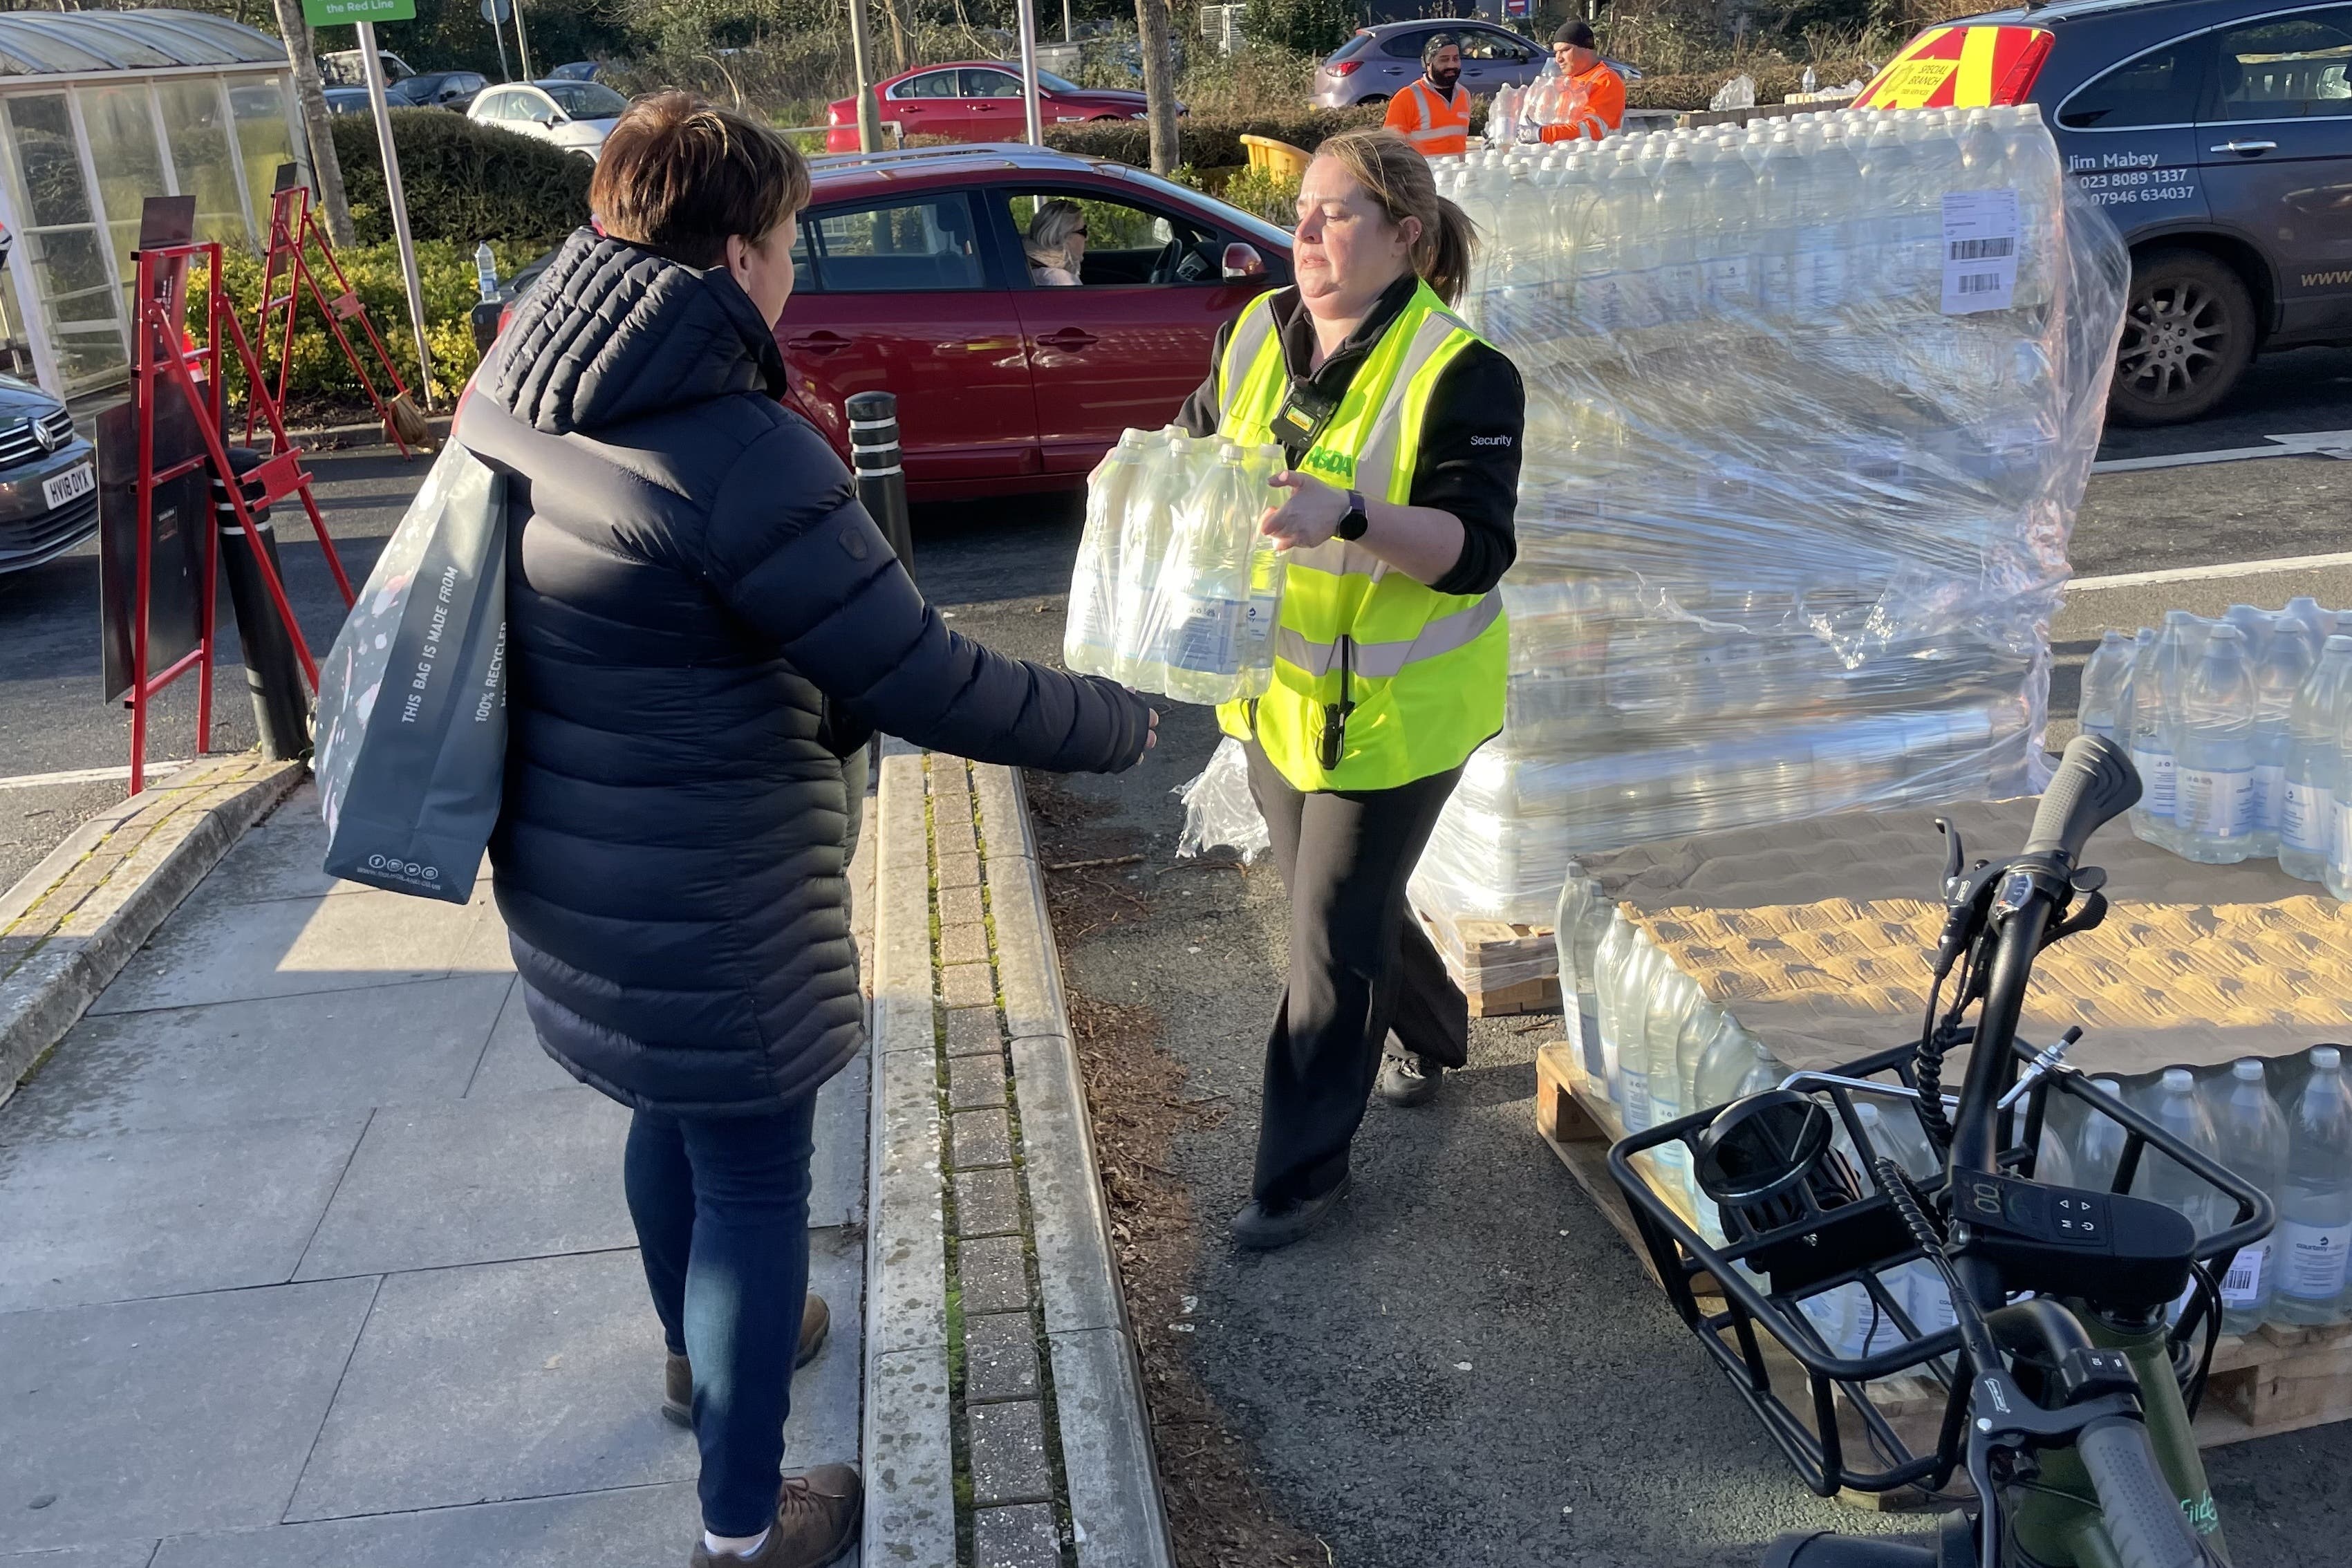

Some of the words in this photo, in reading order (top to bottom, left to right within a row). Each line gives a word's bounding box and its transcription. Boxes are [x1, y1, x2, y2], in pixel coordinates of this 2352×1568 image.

[326, 3, 344, 14] the
[347, 1, 368, 12] Red
[371, 0, 394, 9] Line
[2068, 154, 2096, 173] Jim
[2103, 151, 2158, 169] Mabey
[2080, 176, 2107, 189] 023
[2111, 171, 2148, 187] 8089
[2152, 169, 2187, 183] 1337
[2091, 191, 2137, 205] 07946
[2140, 186, 2194, 202] 634037
[1470, 434, 1512, 447] Security
[1305, 445, 1353, 478] ASDA
[49, 476, 73, 504] HV18
[71, 467, 90, 493] OYX
[438, 566, 458, 604] FROM
[427, 604, 448, 643] MADE
[422, 644, 438, 659] IS
[412, 662, 431, 690] BAG
[402, 693, 422, 723] THIS
[474, 692, 496, 722] 100%
